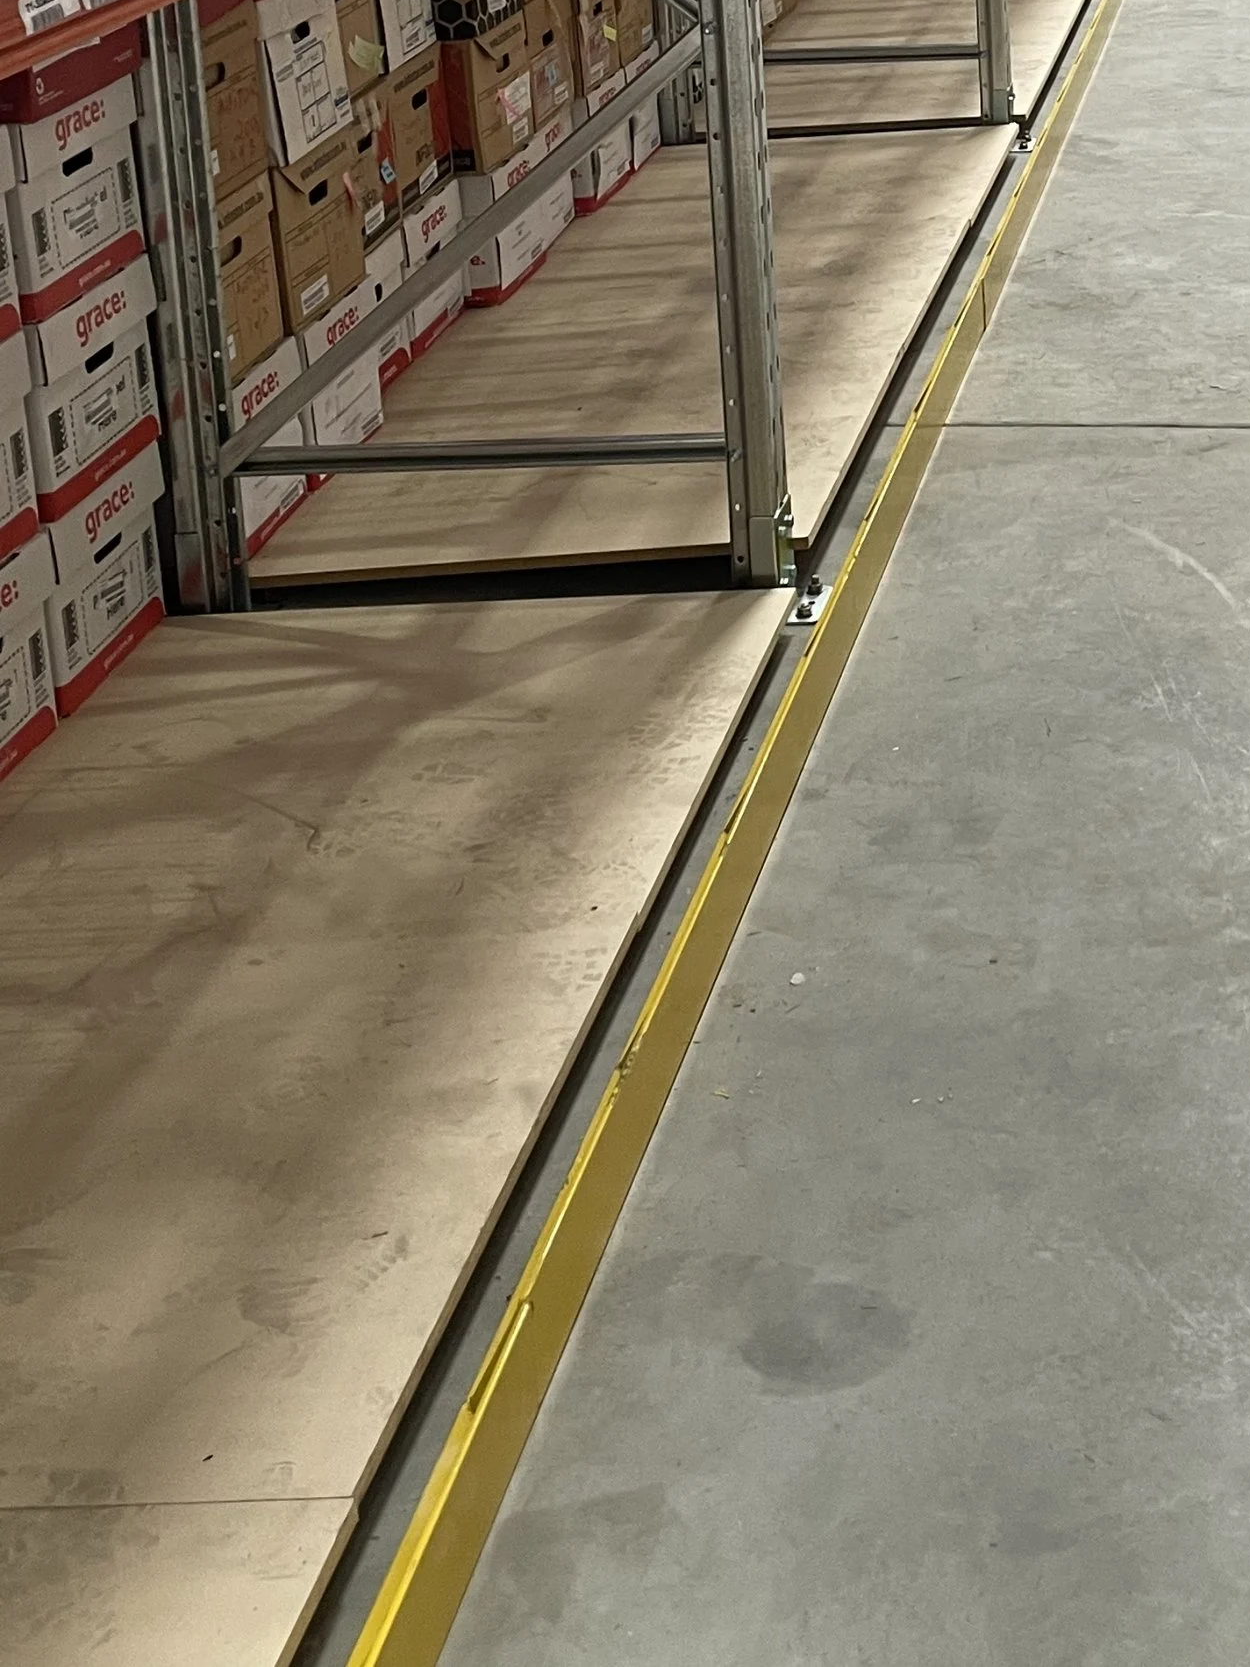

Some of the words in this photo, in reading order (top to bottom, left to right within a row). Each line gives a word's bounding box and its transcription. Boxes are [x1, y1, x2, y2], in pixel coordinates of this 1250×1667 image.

[54, 99, 107, 152] grace:
[75, 289, 127, 347] grace:
[240, 369, 281, 420] grace:
[84, 480, 136, 544] grace:
